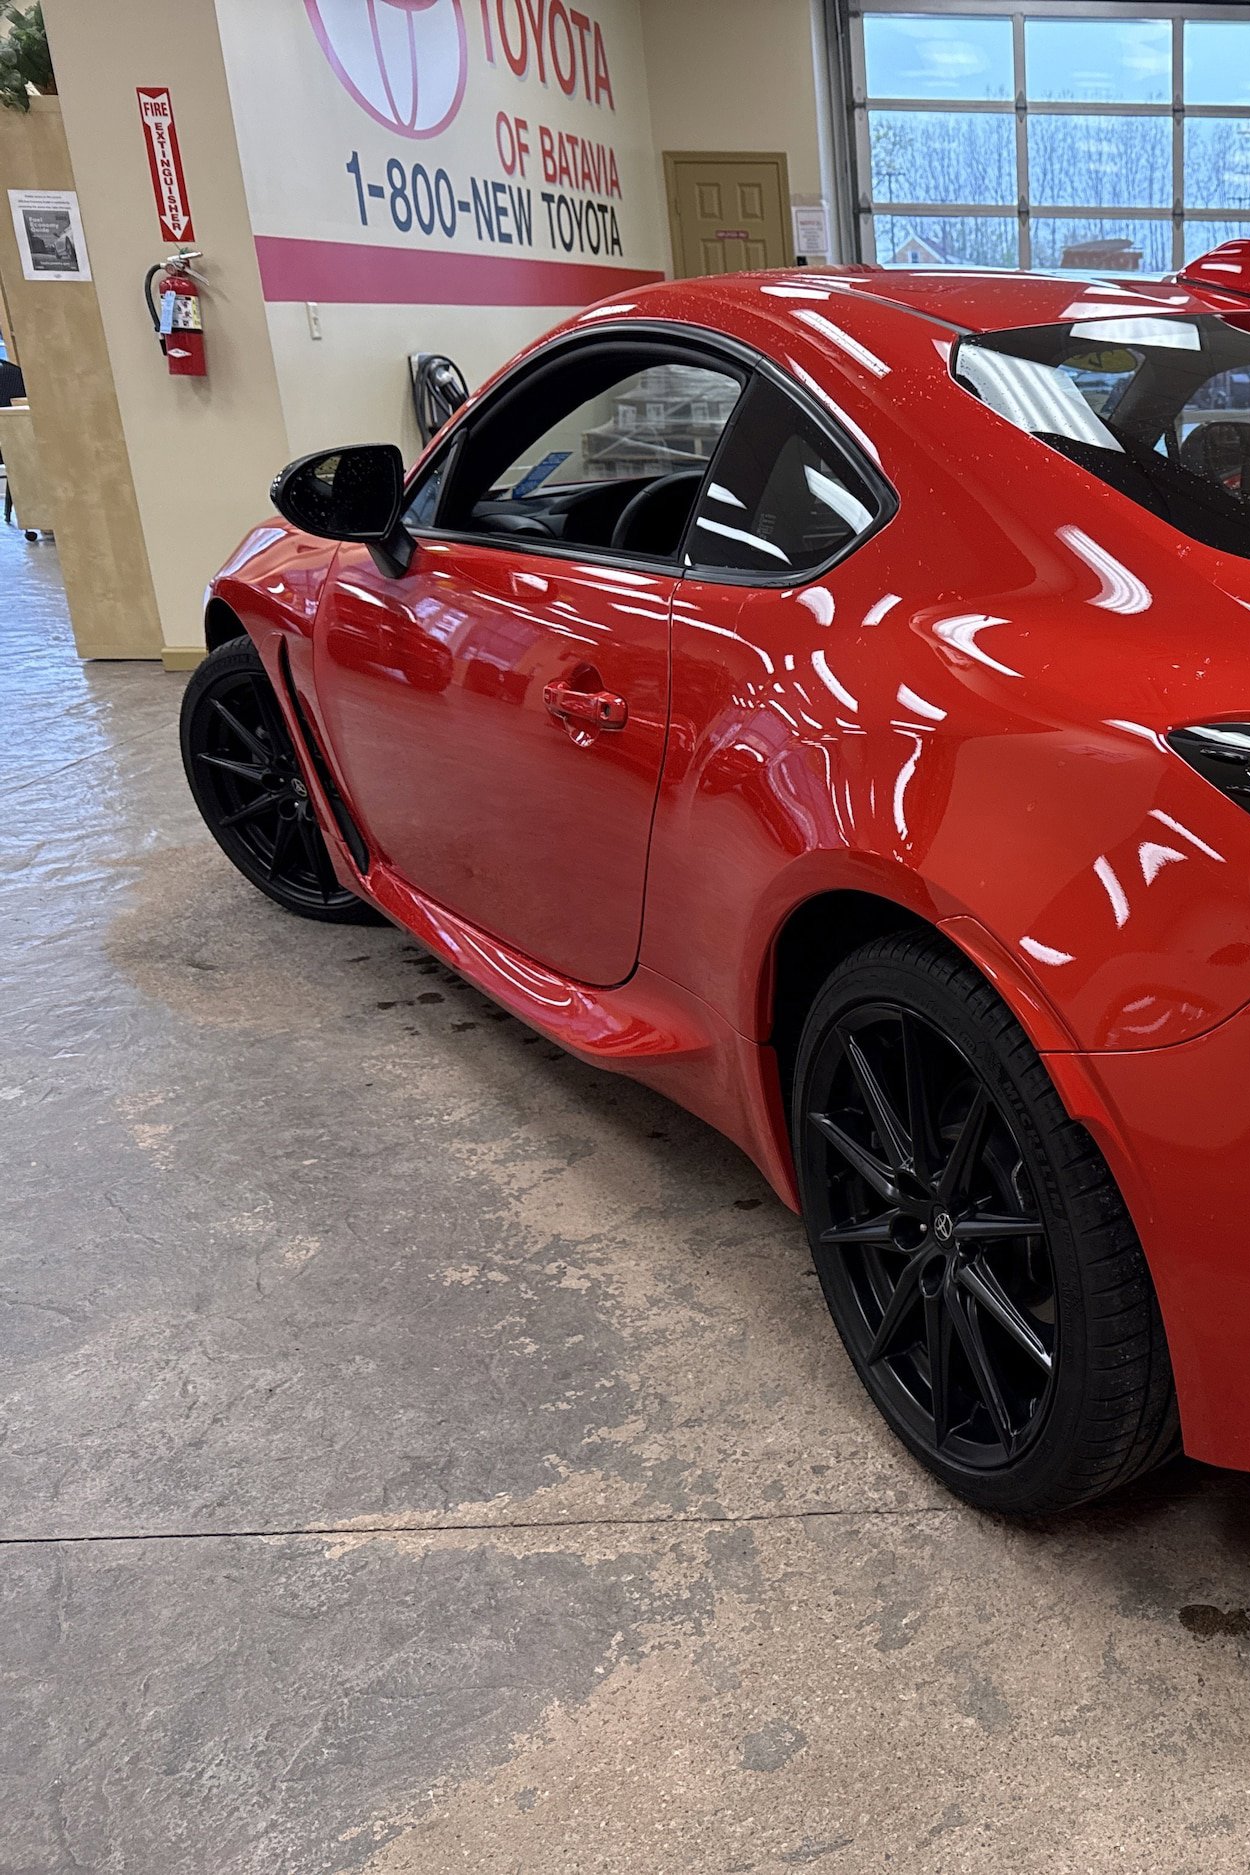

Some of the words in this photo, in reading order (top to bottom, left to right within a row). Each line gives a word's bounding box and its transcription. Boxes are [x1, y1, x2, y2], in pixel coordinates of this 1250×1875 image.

[143, 102, 169, 117] FIRE
[496, 110, 531, 177] OF
[538, 125, 623, 200] BATAVIA
[154, 122, 182, 231] EXTINGUISHER
[346, 150, 533, 247] 1-800-NEW
[541, 191, 624, 257] TOYOTA
[1002, 1080, 1065, 1211] MICHELIN
